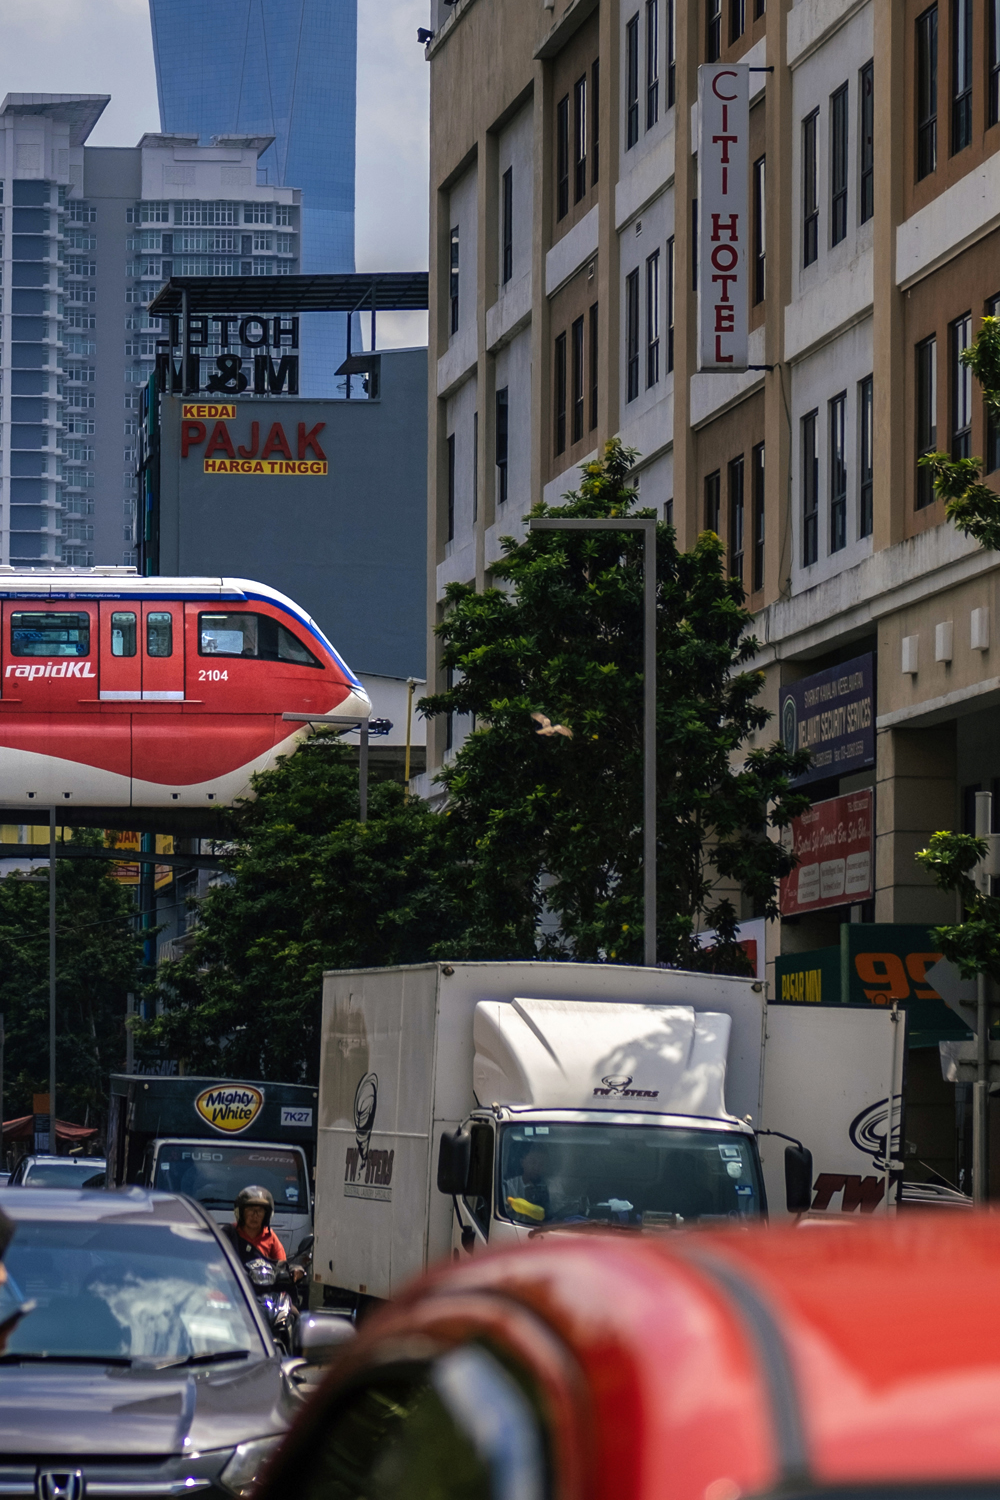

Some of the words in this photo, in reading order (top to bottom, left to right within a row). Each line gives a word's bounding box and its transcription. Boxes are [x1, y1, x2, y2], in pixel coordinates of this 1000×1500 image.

[711, 70, 738, 195] CITI
[710, 213, 739, 363] HOTEL
[182, 405, 236, 418] KEDAI
[181, 421, 327, 460] PAJAK
[204, 460, 264, 474] HARGA
[267, 461, 328, 474] TINGGI
[5, 661, 96, 681] rapidKL
[198, 669, 229, 682] 2104
[821, 705, 846, 742] SECURITY
[846, 696, 871, 734] SERVICES
[781, 971, 804, 1002] PASAR
[206, 1091, 254, 1108] Mighty
[211, 1105, 253, 1122] White
[283, 1112, 310, 1122] 7K27
[181, 1151, 223, 1162] FUSO
[248, 1154, 294, 1163] CANTER
